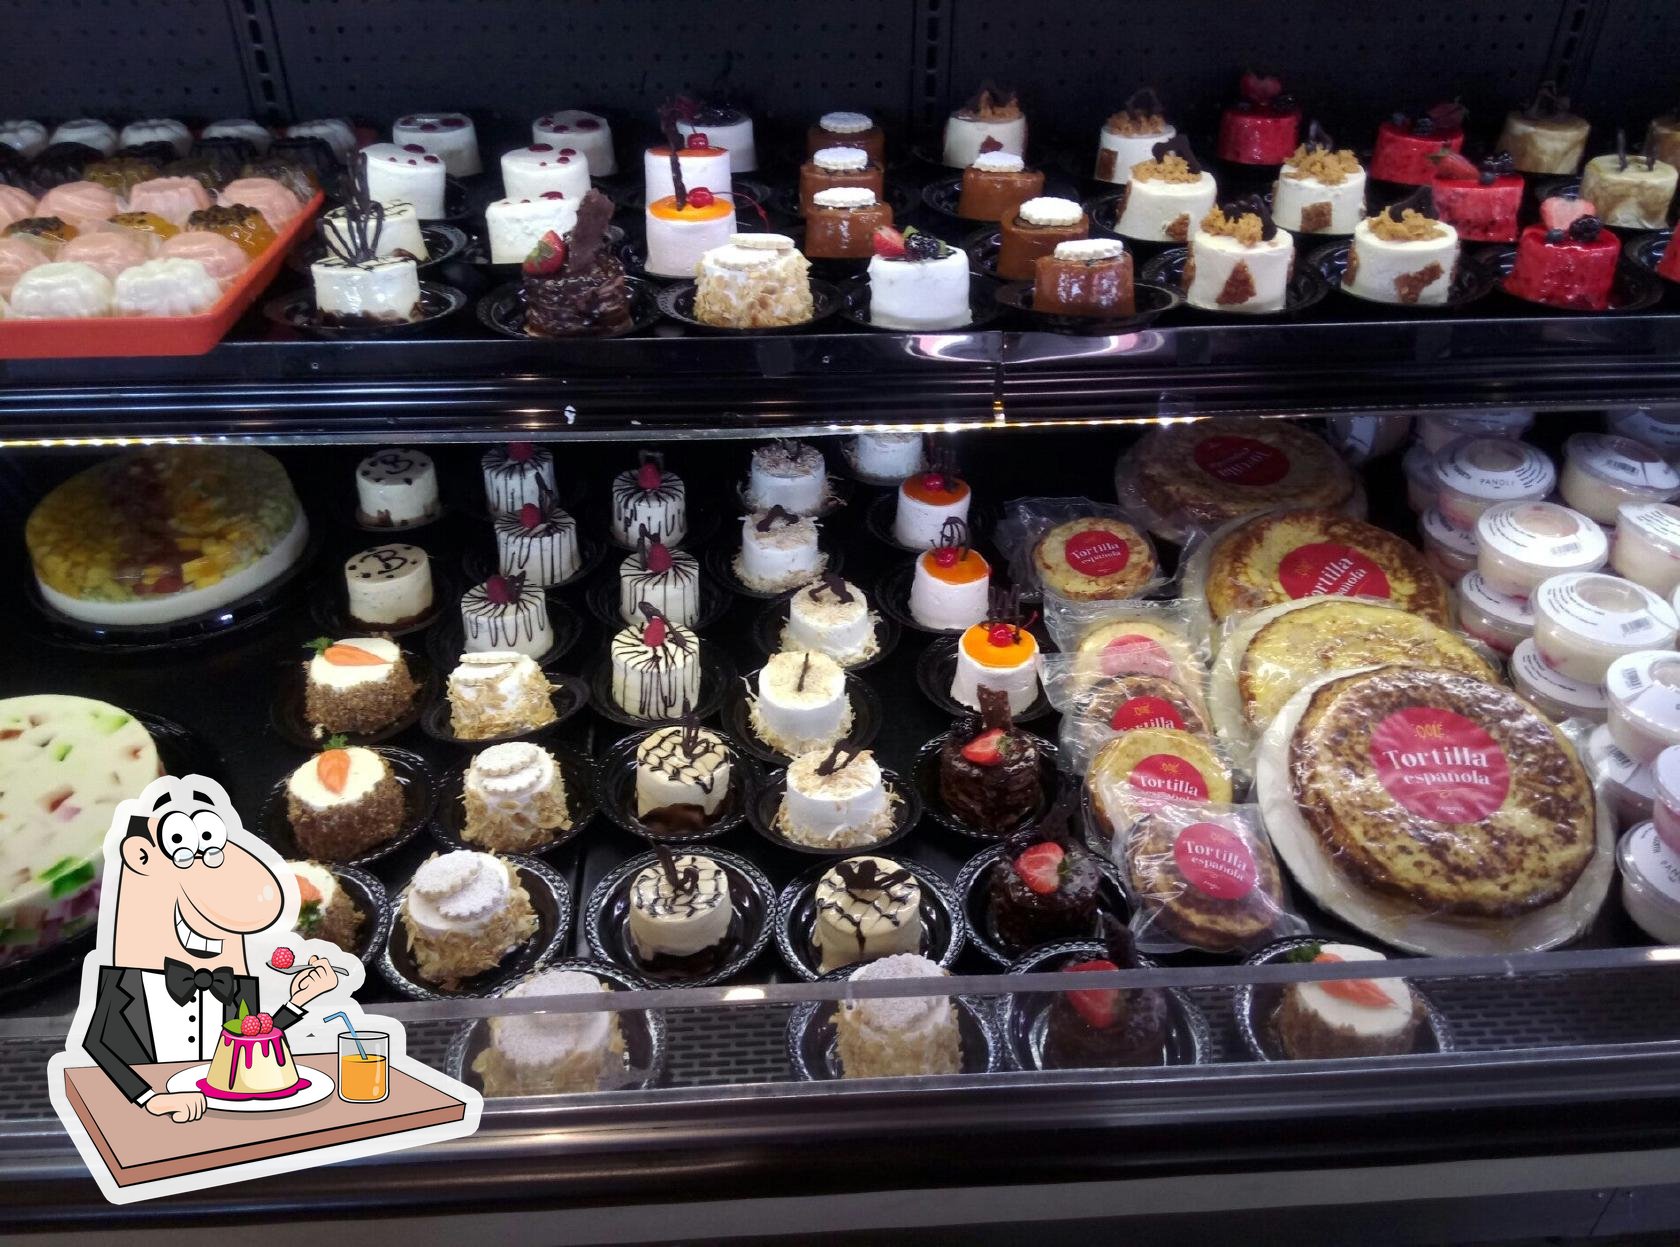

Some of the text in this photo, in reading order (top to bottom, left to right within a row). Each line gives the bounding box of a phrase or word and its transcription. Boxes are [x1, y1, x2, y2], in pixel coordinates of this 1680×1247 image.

[1072, 542, 1120, 559] Tortilla
[1303, 557, 1354, 597] ortilla
[1382, 746, 1489, 770] Tortilla
[1140, 775, 1199, 797] Tortilla
[1182, 840, 1247, 872] Tortilla
